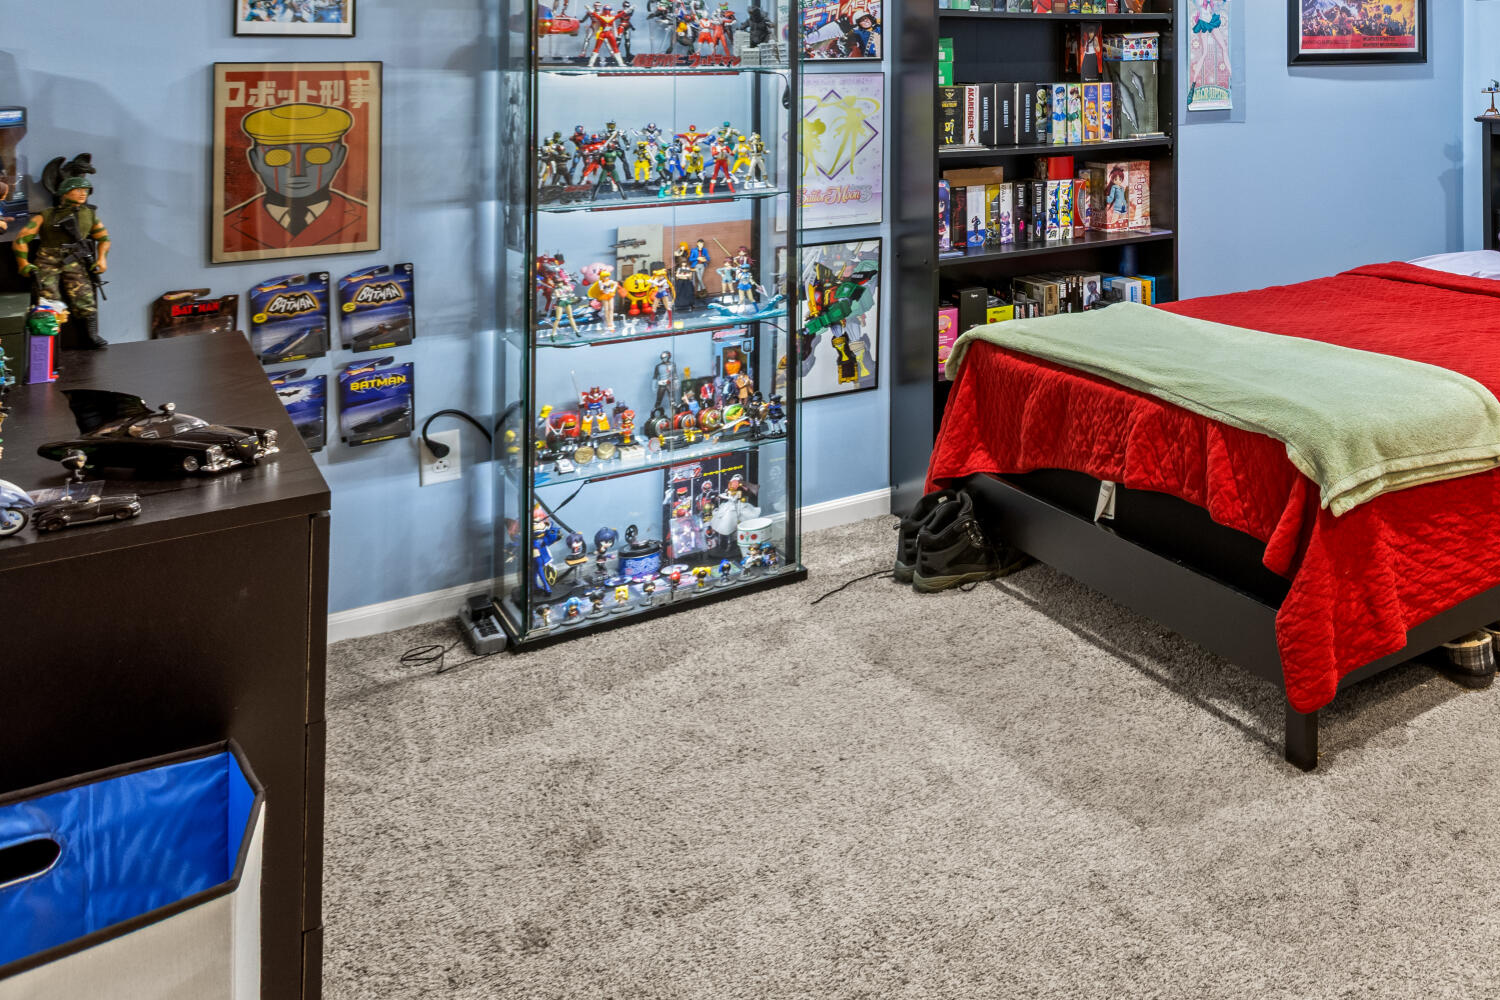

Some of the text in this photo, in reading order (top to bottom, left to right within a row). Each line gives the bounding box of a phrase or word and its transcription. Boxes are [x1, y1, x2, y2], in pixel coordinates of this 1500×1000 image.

[224, 78, 370, 109] ロボット刑事
[824, 184, 861, 205] Moon
[1134, 176, 1147, 205] figma
[357, 283, 401, 303] BATMAN
[268, 294, 316, 313] BATMAN
[350, 375, 407, 391] BATMAN
